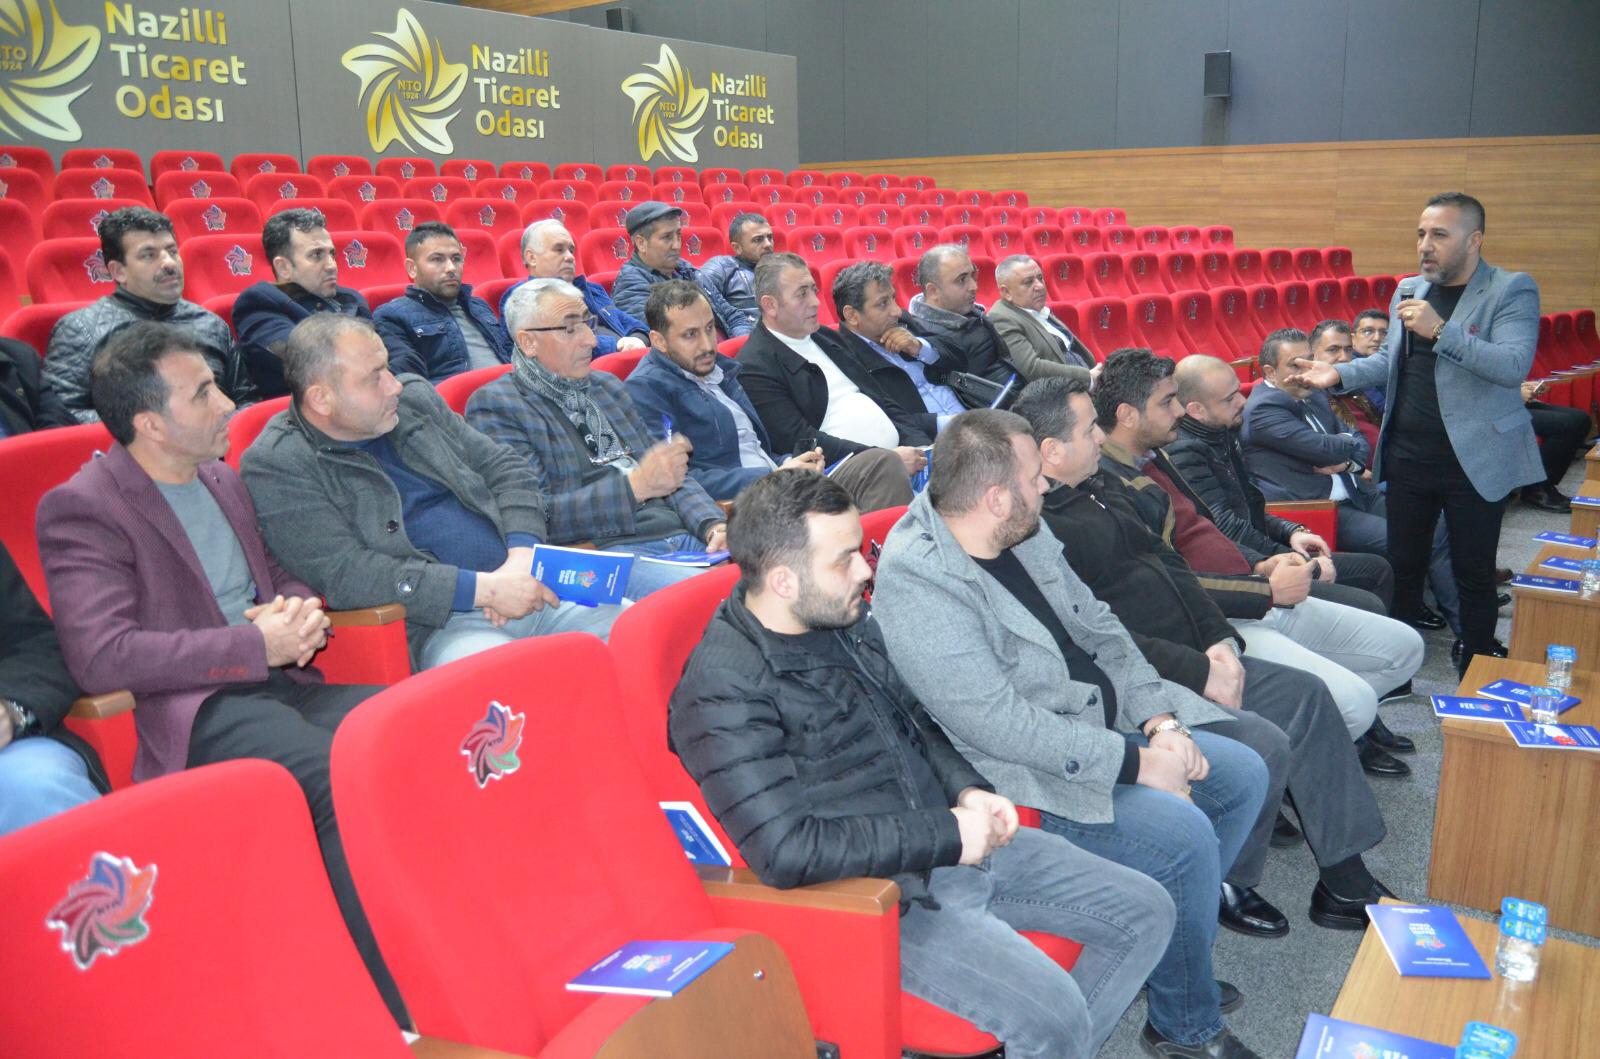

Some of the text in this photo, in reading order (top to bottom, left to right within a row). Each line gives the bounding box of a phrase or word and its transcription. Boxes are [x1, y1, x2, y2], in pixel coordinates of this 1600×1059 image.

[104, 1, 228, 45] Nazilli
[0, 45, 27, 61] TO
[110, 43, 247, 85] Ticaret
[472, 44, 549, 77] Nazilli
[397, 79, 422, 92] NTO
[474, 77, 561, 109] Ticaret
[711, 72, 767, 98] Nazilli
[116, 84, 224, 123] Odası
[713, 99, 774, 124] Ticaret
[476, 109, 545, 139] Odası
[714, 125, 763, 149] Odası
